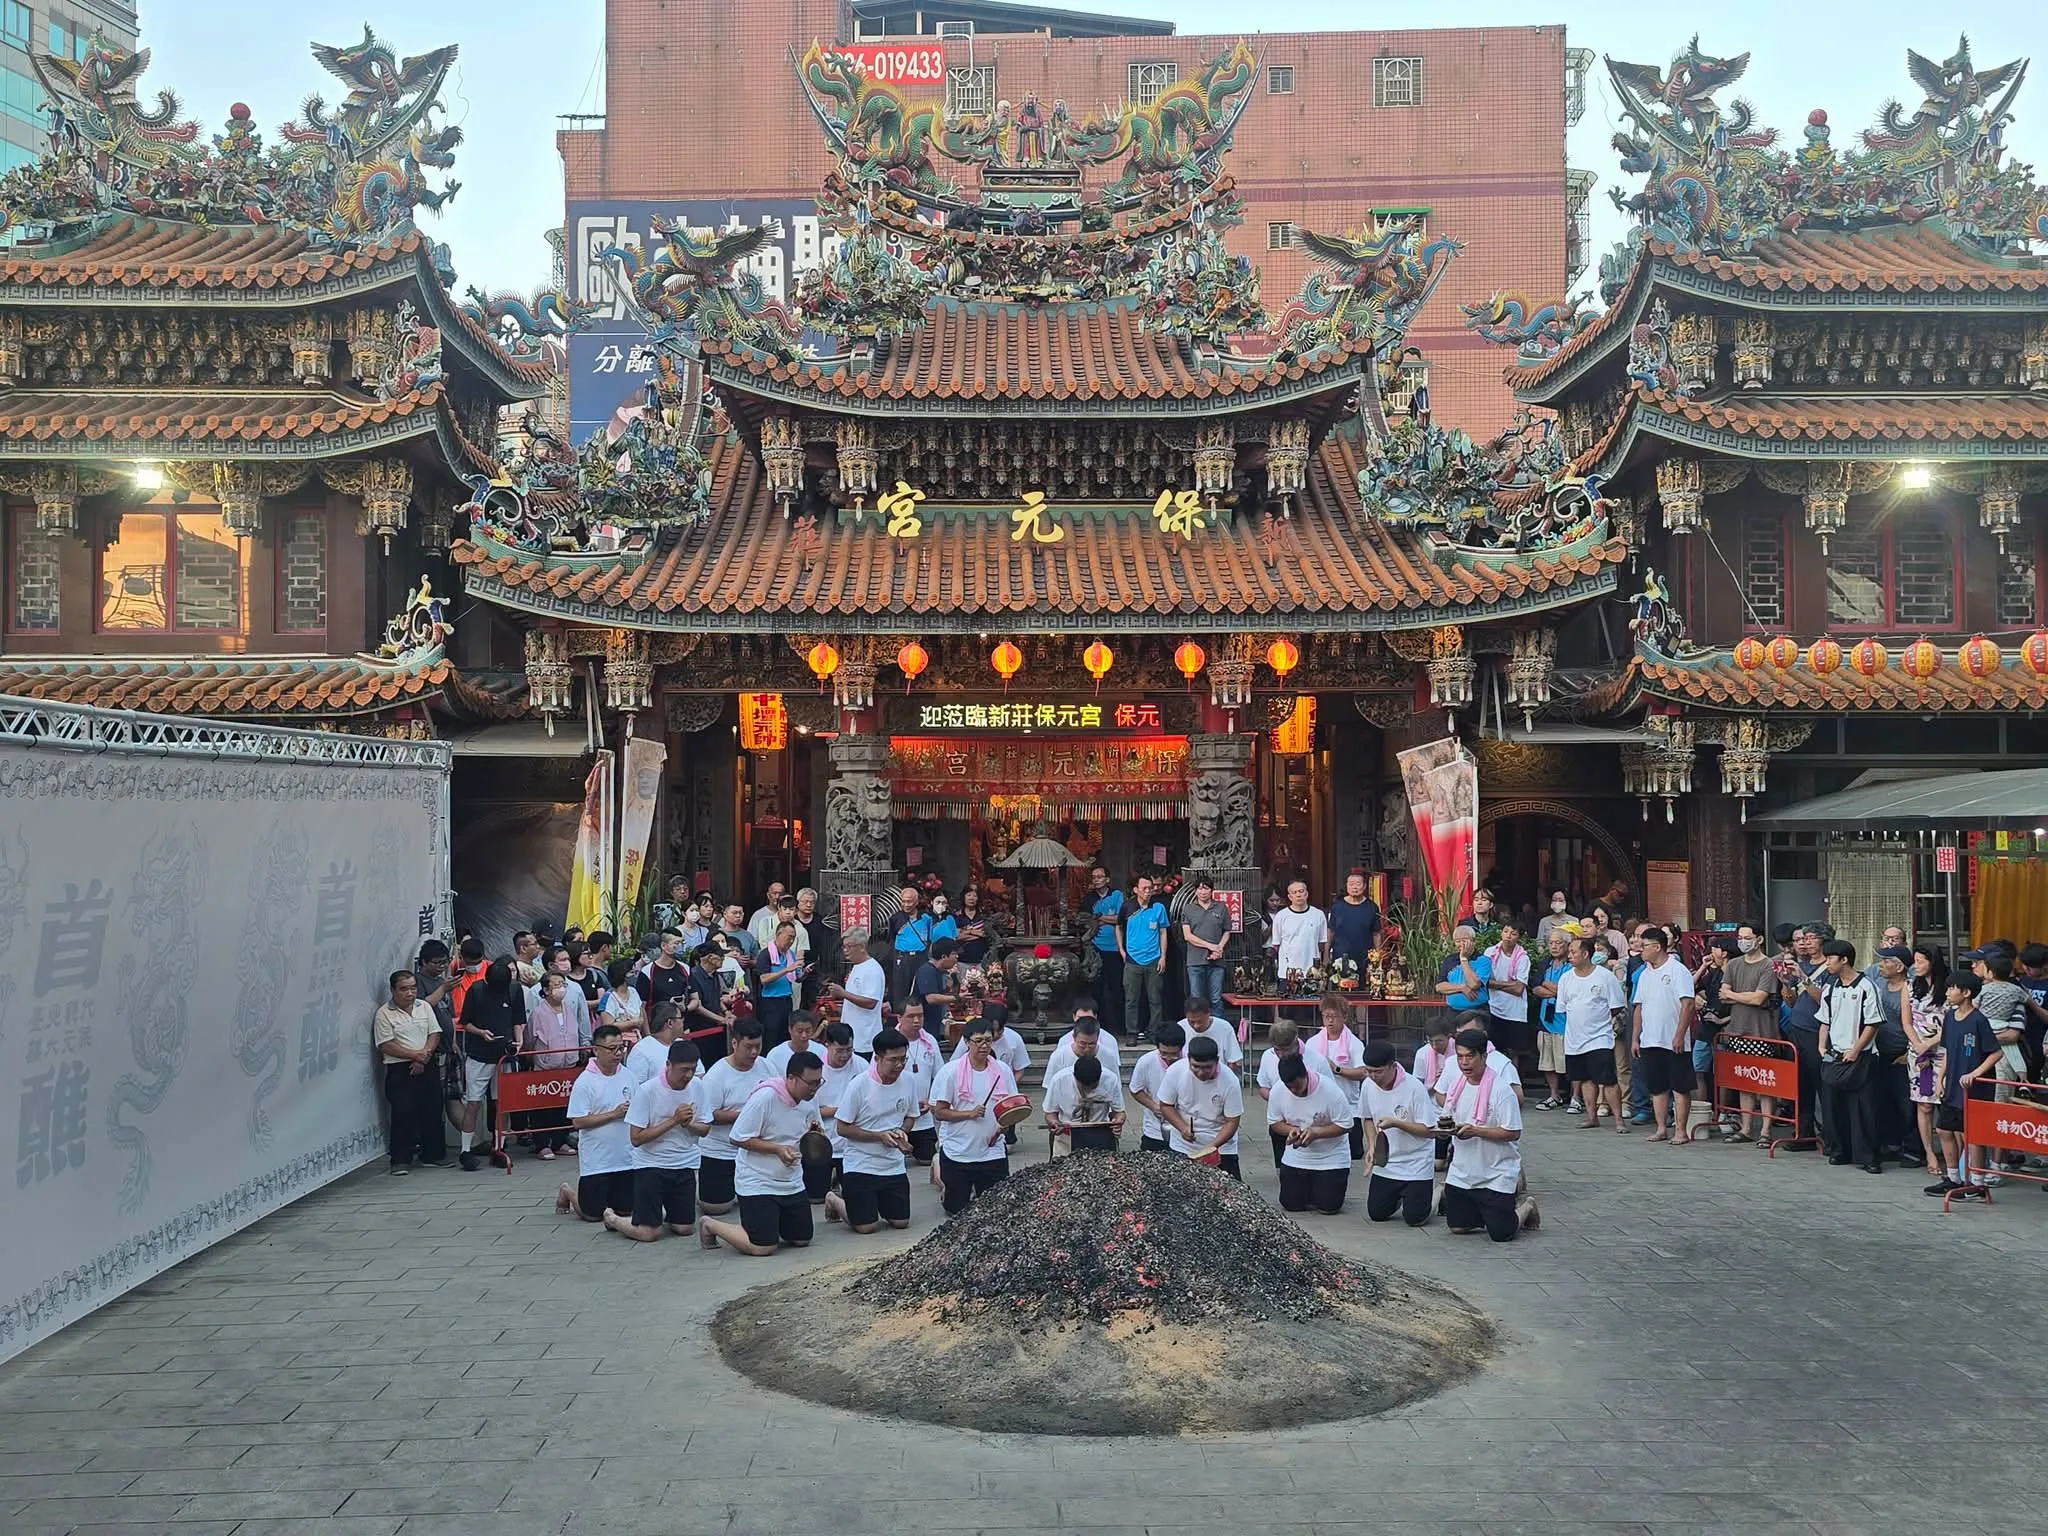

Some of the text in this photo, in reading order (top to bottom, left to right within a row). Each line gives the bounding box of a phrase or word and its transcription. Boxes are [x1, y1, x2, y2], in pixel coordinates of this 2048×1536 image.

[823, 51, 942, 79] 26-019433
[920, 703, 1160, 728] 迎蒞臨新莊保元宮 保元
